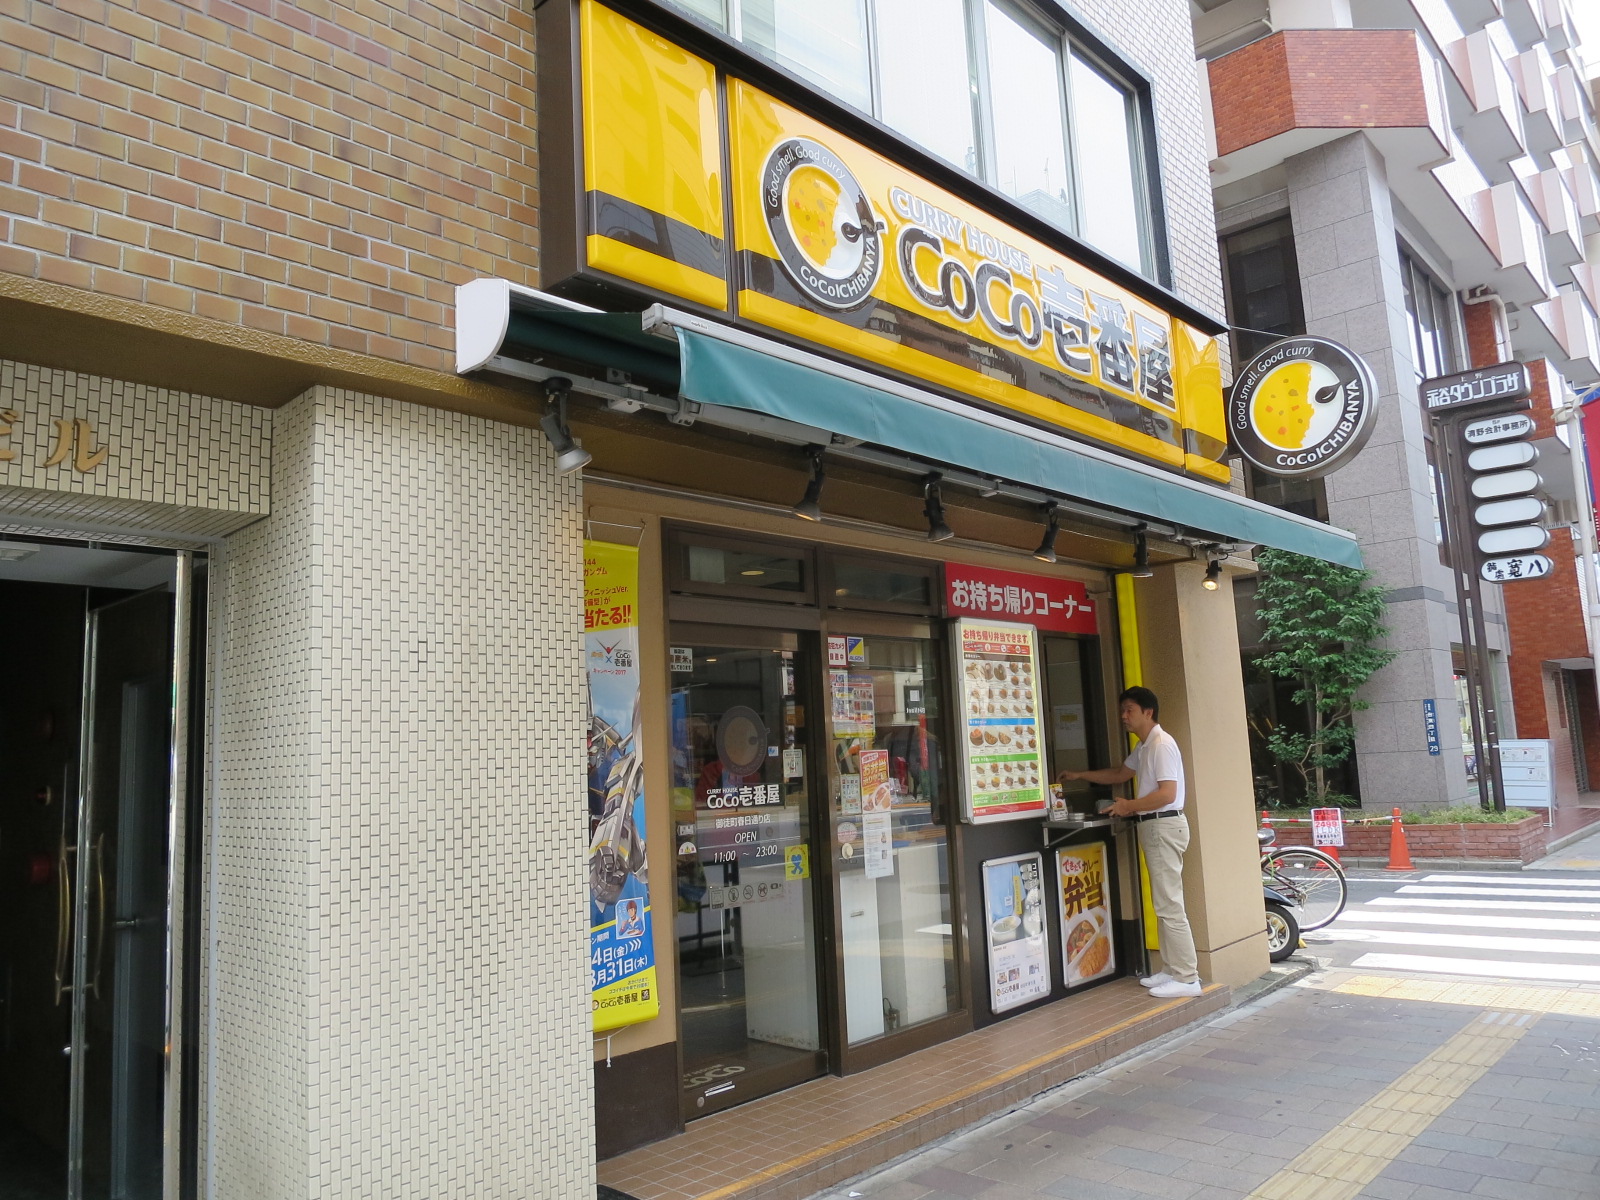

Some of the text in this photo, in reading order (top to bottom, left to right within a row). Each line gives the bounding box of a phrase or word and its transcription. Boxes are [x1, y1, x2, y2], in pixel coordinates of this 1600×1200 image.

[767, 170, 781, 208] Good
[795, 145, 821, 161] Good
[821, 155, 847, 180] curry
[891, 187, 1033, 280] CURRY HOUSE
[800, 236, 876, 298] CoCoICHIBANYA
[896, 224, 1176, 412] CoCo壱番屋
[1236, 346, 1315, 430] Good smell. Good curry
[1276, 379, 1360, 466] CoCoICHIBANYA
[951, 578, 1093, 619] お持ち帰りコーナー
[706, 784, 780, 809] CoCo壱番屋
[722, 787, 739, 795] HOUSE
[715, 813, 771, 829] 御徒町春日通り店
[734, 831, 757, 844] OPEN
[713, 850, 736, 864] 11:00
[755, 844, 778, 858] 23:00
[1062, 859, 1100, 874] できたて カレー
[1063, 870, 1104, 918] 弁当
[591, 931, 609, 944] ン期間
[600, 992, 639, 1009] CoCo壱番屋
